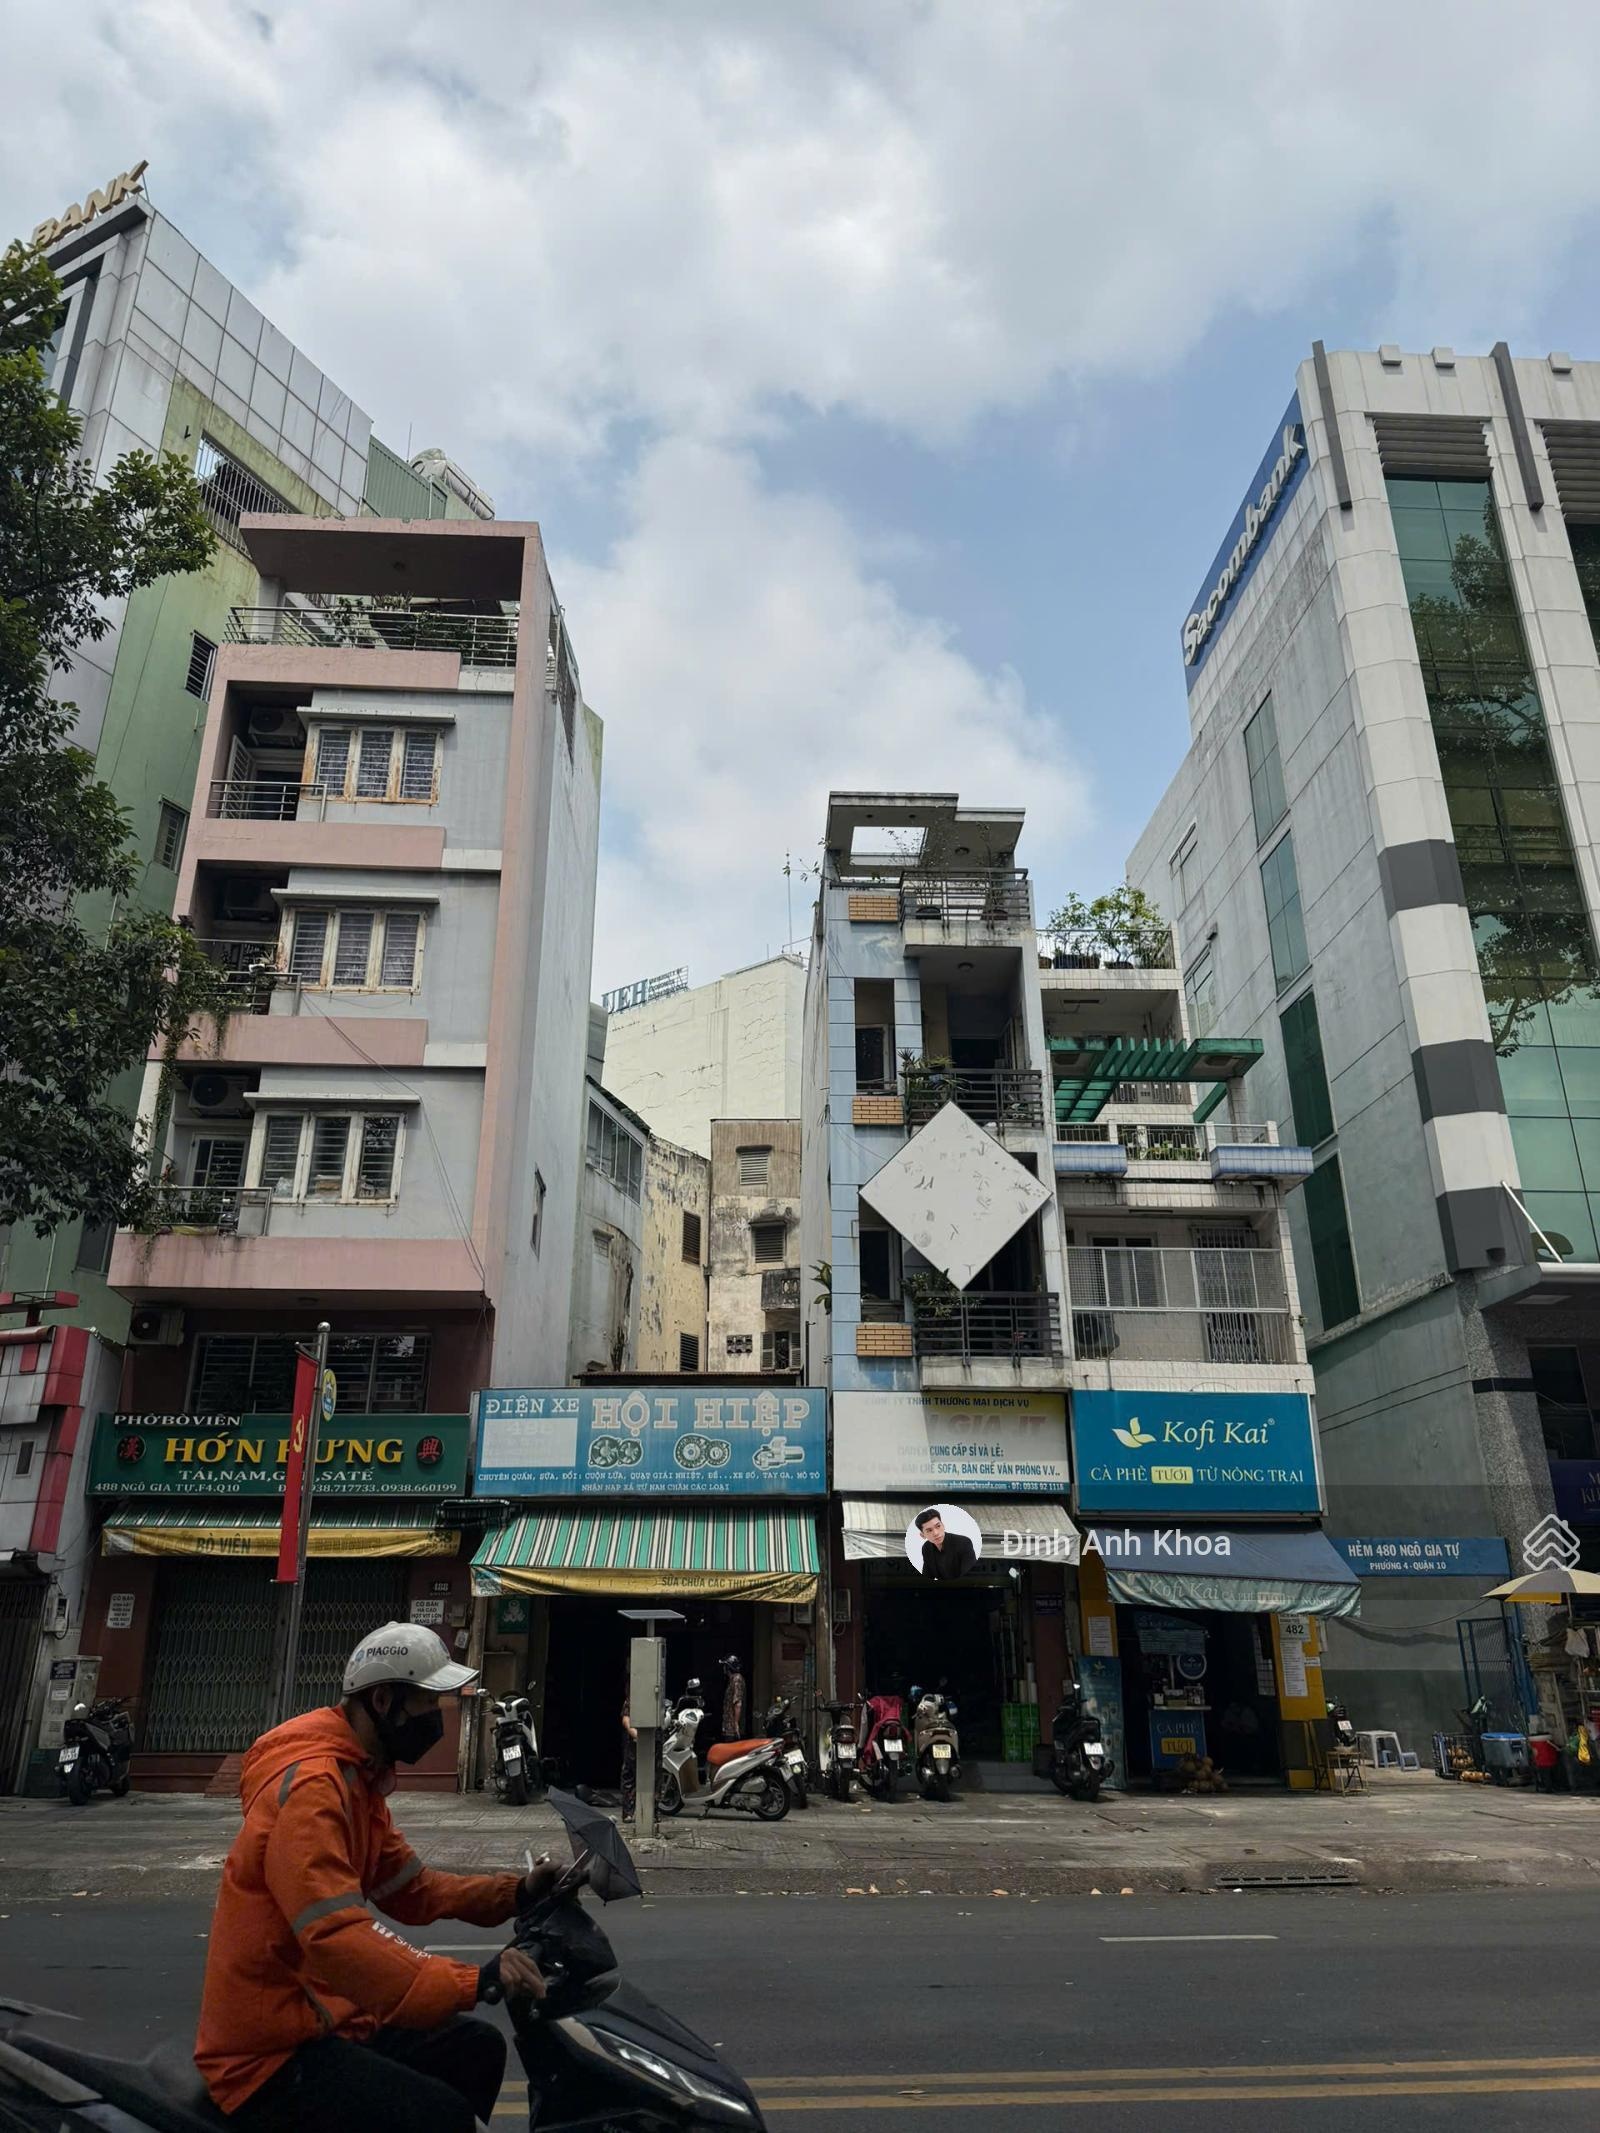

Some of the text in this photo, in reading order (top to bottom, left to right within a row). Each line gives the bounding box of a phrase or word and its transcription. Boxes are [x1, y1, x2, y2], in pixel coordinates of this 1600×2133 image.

[1183, 423, 1305, 667] Sacombank
[485, 1395, 580, 1417] ĐIỆN XE
[992, 1398, 1015, 1408] DỊCH
[1017, 1399, 1030, 1409] VỤ
[591, 1390, 810, 1437] HỘI HIỆP
[1162, 1418, 1269, 1450] Kofi Kai
[164, 1431, 265, 1464] HỚN
[929, 1446, 950, 1457] CUNG
[951, 1442, 967, 1457] CẤP
[978, 1444, 989, 1457] VÀ
[979, 1458, 995, 1475] GHẾ
[1015, 1462, 1040, 1476] PHÒNG
[1090, 1464, 1304, 1485] CÀ PHÊ TƯƠI TỪ NÔNG TRẠI
[478, 1471, 510, 1481] CHUYÊN
[584, 1471, 606, 1482] CUỘN
[630, 1471, 651, 1482] QUẠT
[763, 1472, 779, 1480] TAY
[796, 1471, 808, 1480] MÔ
[809, 1471, 820, 1480] TÔ
[95, 1483, 118, 1492] 488
[150, 1483, 171, 1492] GIA
[649, 1483, 666, 1491] NAM
[709, 1483, 729, 1492] LOẠI
[195, 1533, 214, 1553] BÒ
[218, 1532, 251, 1554] VIÊN
[1348, 1540, 1460, 1559] HẺM 480 NGÔ GIA TỰ
[1369, 1559, 1401, 1570] PHƯỜNG
[1403, 1561, 1409, 1570] 4
[1413, 1560, 1434, 1571] QUẬN
[1436, 1561, 1447, 1570] 10
[708, 1575, 726, 1588] CÁC
[1149, 1576, 1185, 1600] Kofi
[1189, 1581, 1219, 1600] Kai
[1285, 1624, 1304, 1635] 482
[366, 1646, 409, 1658] PIAGGIO
